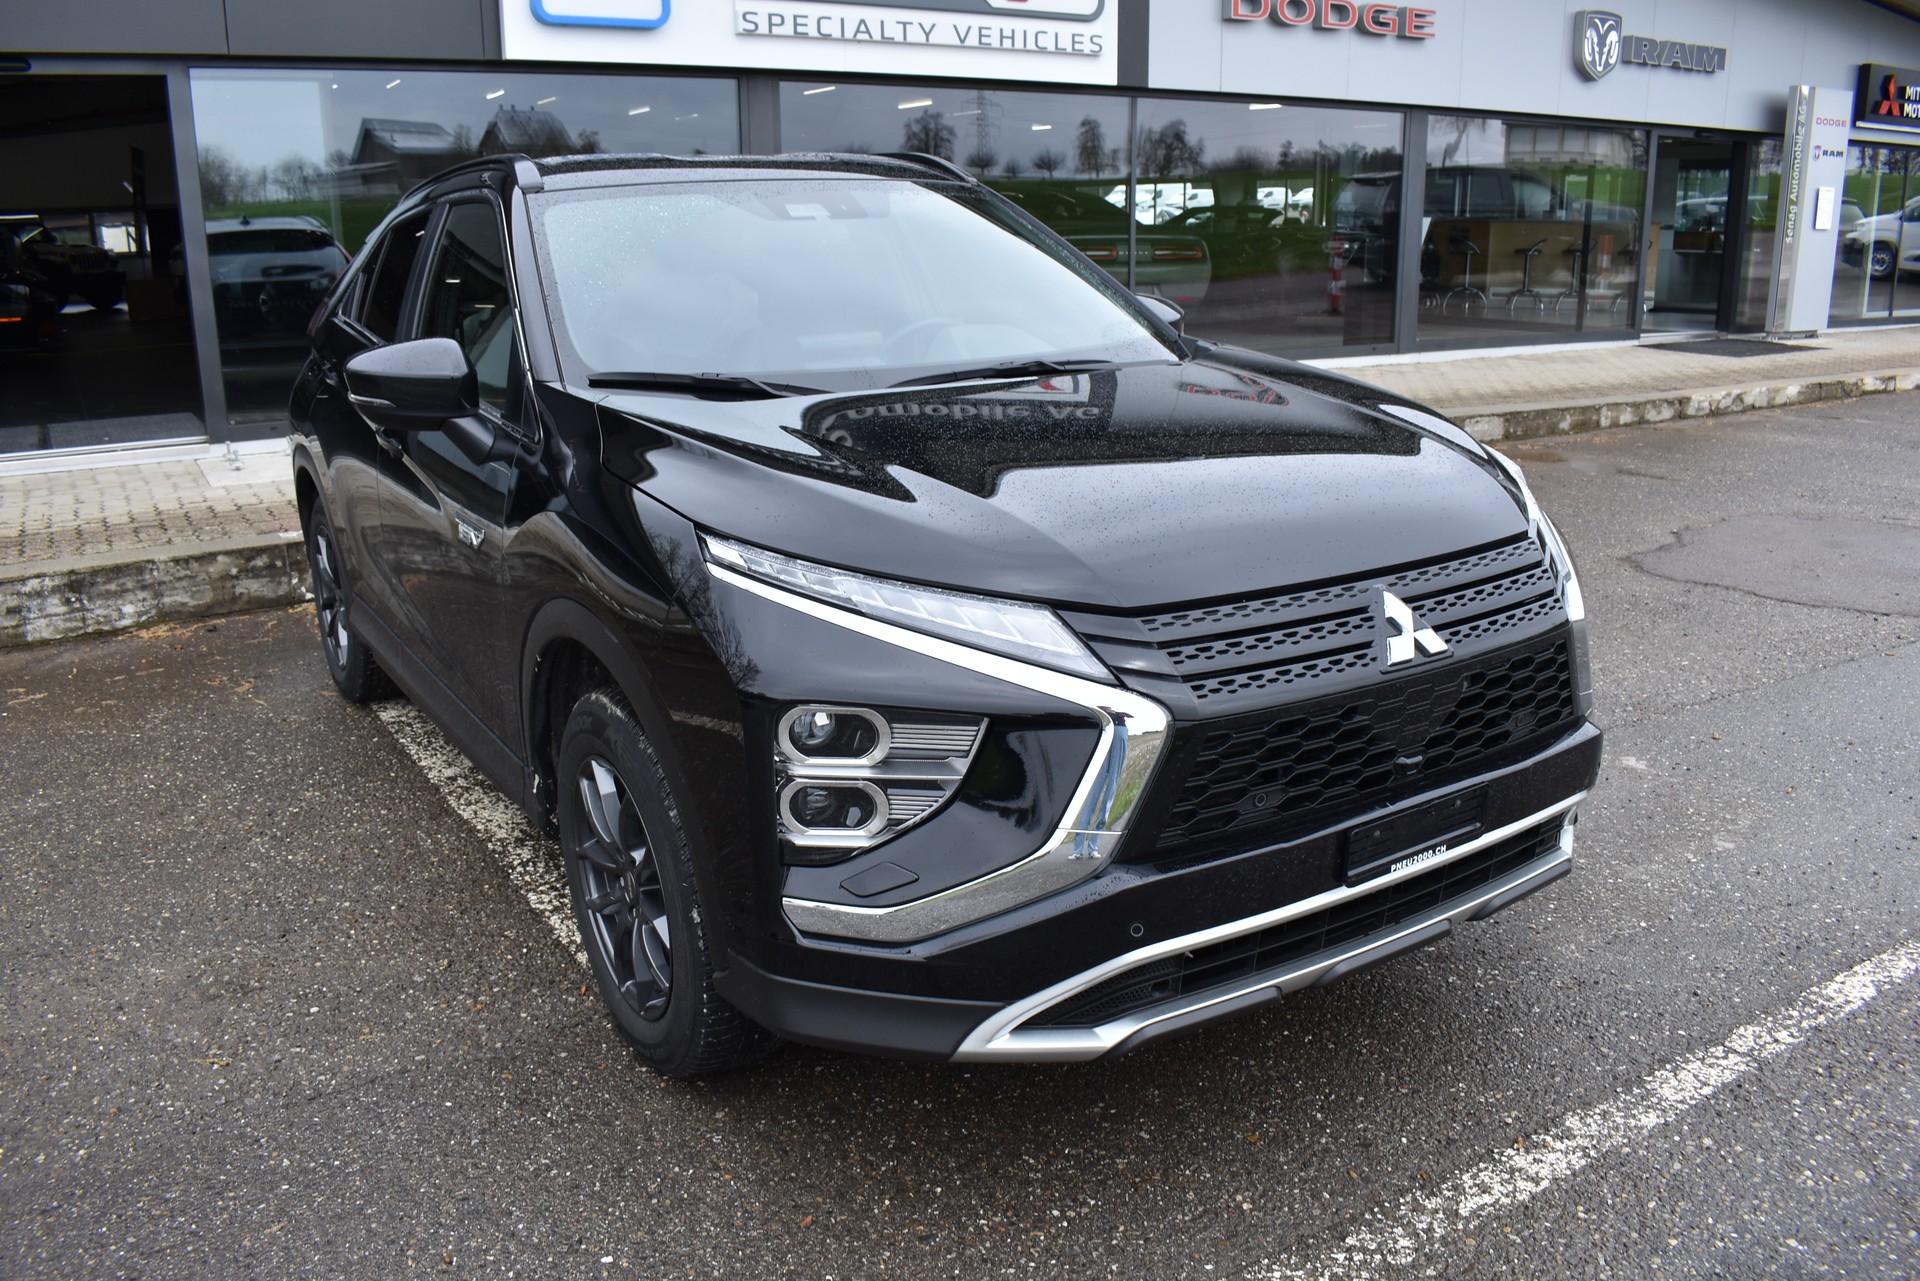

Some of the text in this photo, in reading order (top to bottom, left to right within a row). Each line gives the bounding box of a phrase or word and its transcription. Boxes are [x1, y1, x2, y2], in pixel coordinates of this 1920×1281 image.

[741, 11, 1104, 54] SPECIALTY VEHICLES
[1230, 0, 1437, 38] DODGE
[1630, 36, 1727, 71] RAM
[1815, 117, 1847, 128] DODGE
[1790, 123, 1806, 202] Automobile
[1822, 149, 1844, 158] RAM
[1785, 205, 1798, 244] Senag
[1390, 844, 1447, 873] PNEU2000.CH
